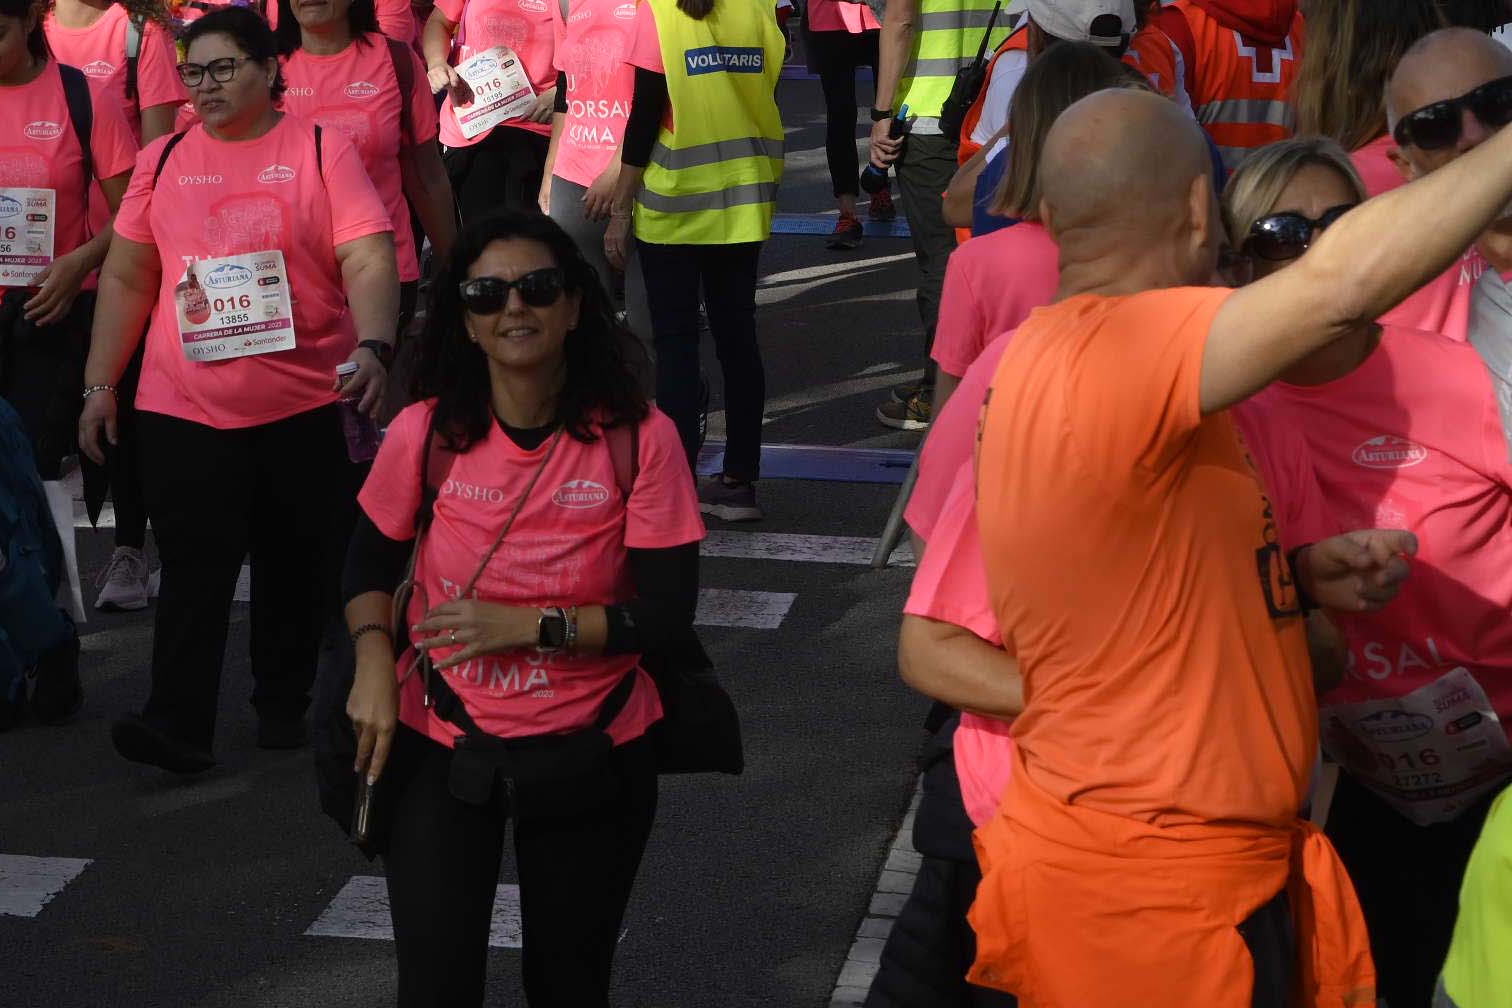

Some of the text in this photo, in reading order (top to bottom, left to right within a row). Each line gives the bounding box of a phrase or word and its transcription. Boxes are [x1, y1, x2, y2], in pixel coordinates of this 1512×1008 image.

[476, 78, 501, 95] 016
[178, 174, 223, 186] OYSHO
[208, 273, 249, 285] ASTURIANA
[214, 295, 251, 312] 016
[220, 314, 249, 325] 13855
[1357, 446, 1423, 463] ASTURIANA
[556, 491, 606, 503] ASTURIANA
